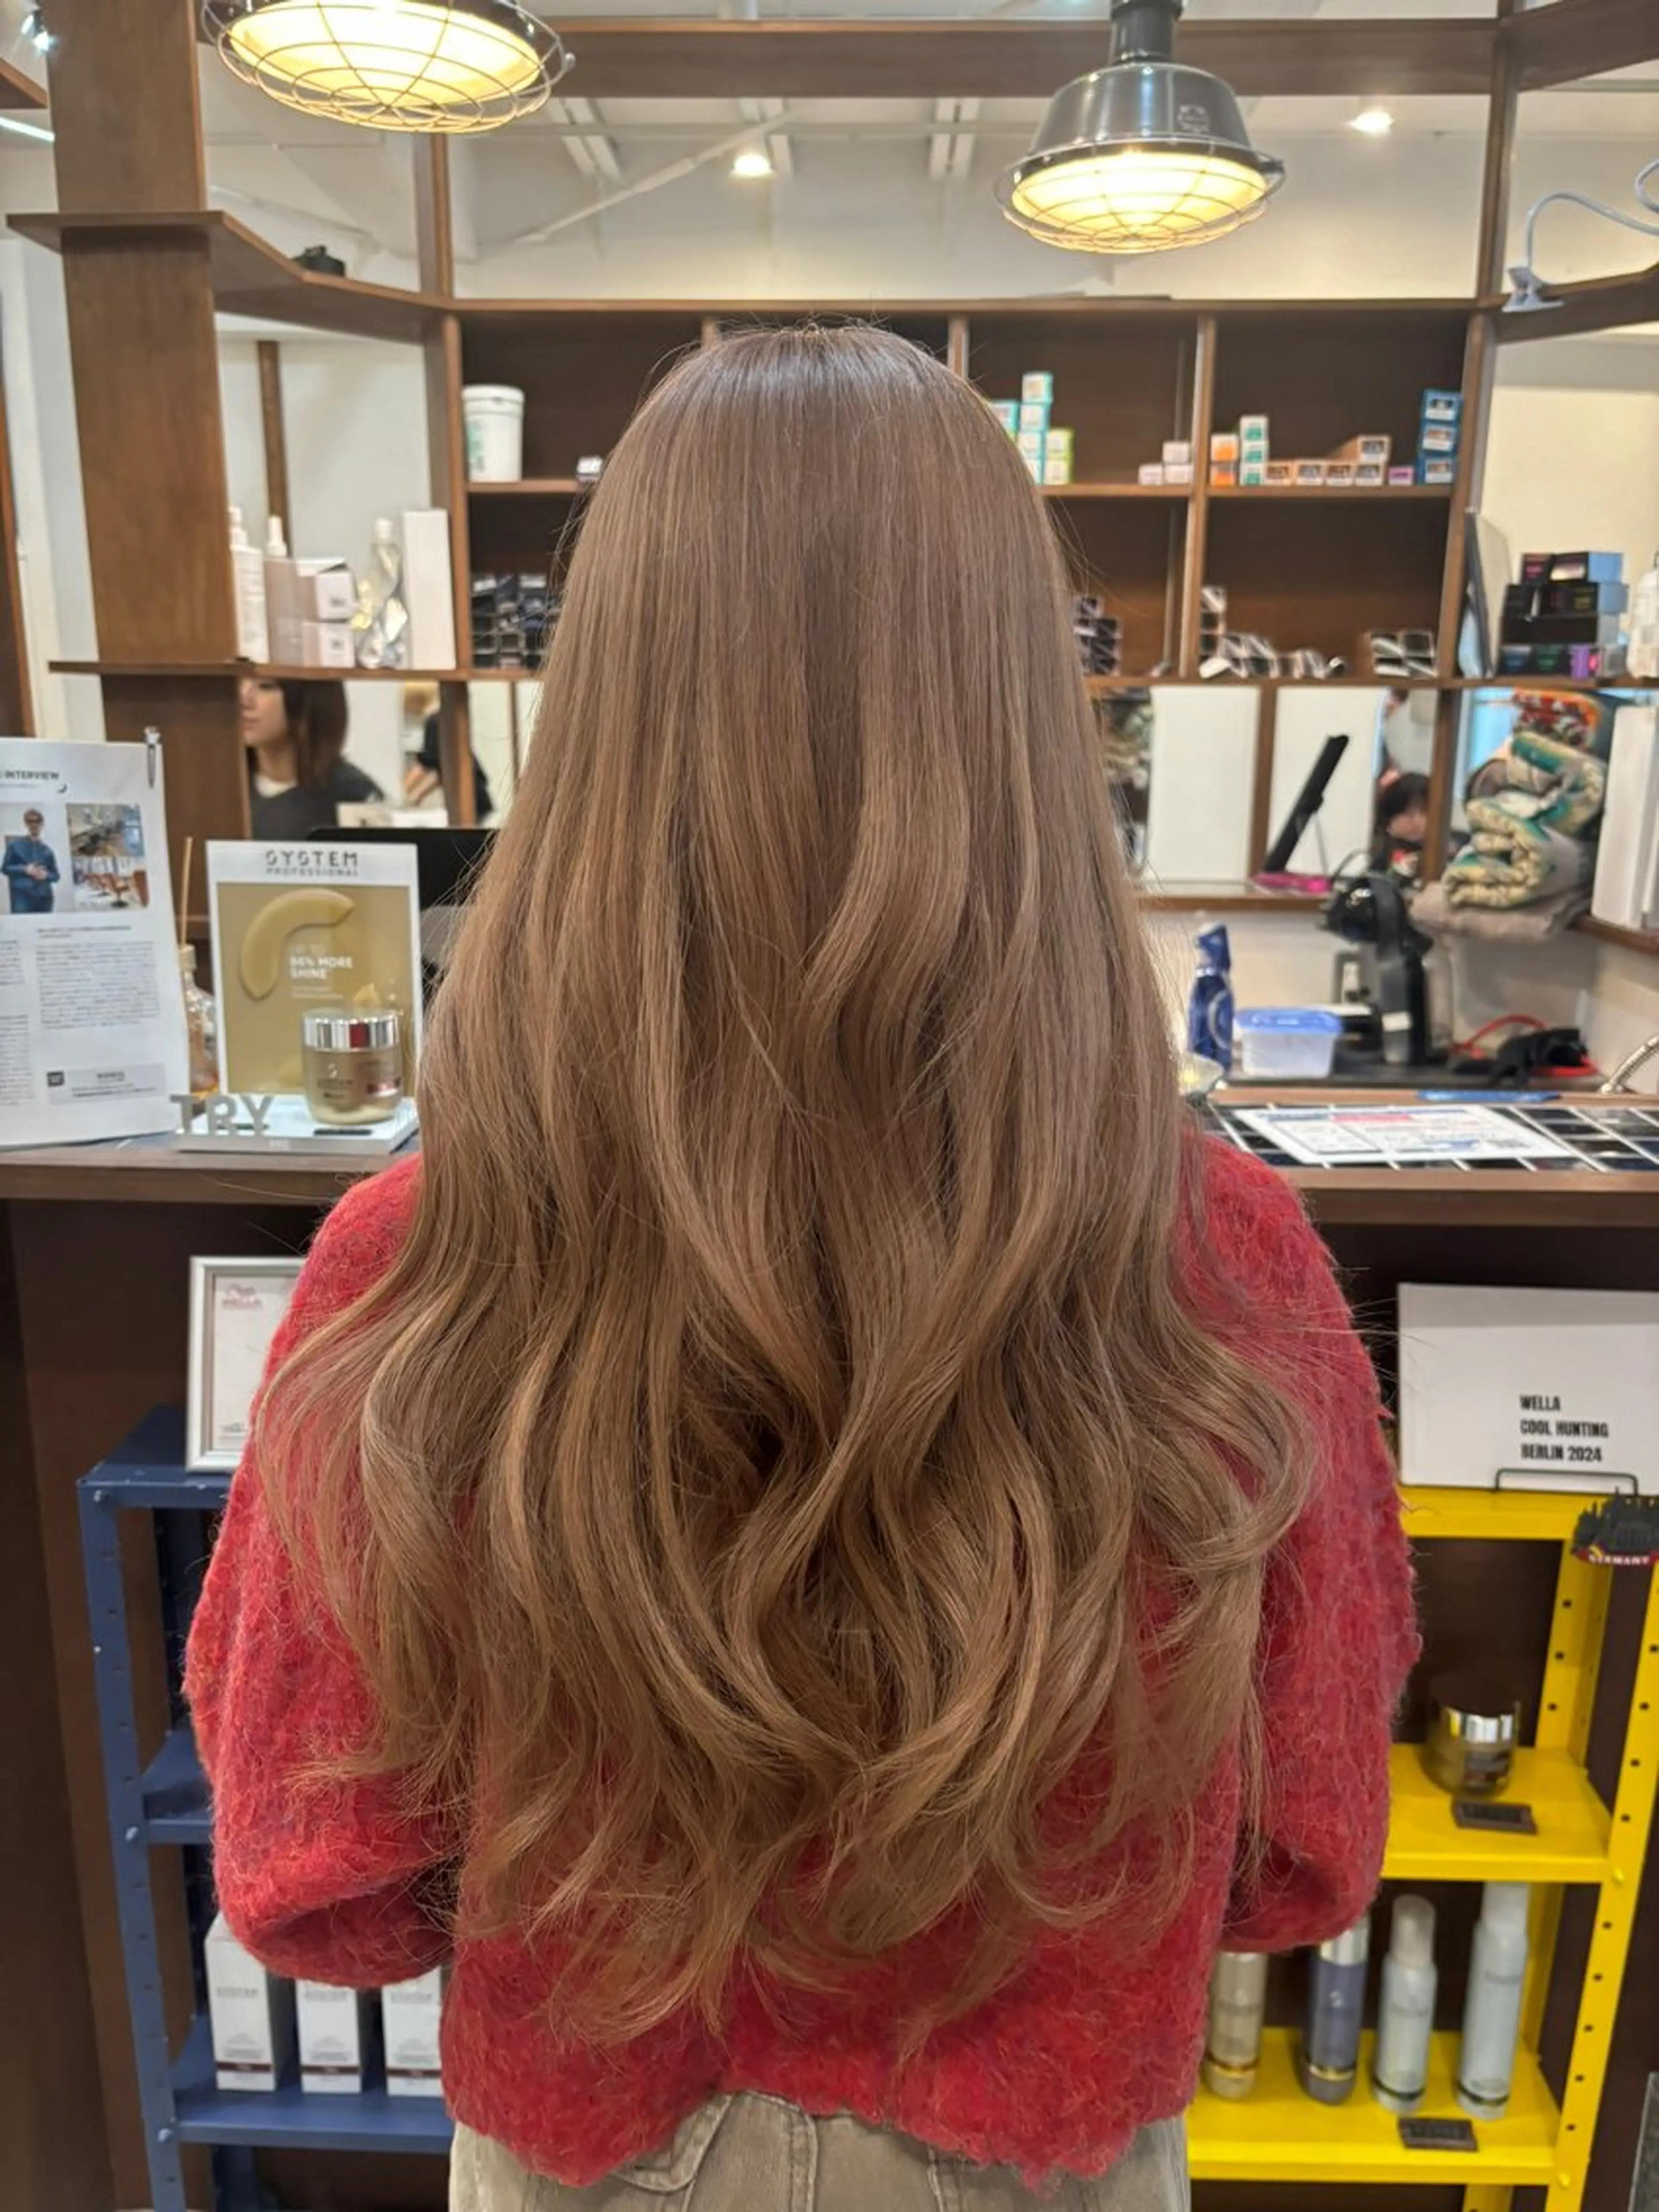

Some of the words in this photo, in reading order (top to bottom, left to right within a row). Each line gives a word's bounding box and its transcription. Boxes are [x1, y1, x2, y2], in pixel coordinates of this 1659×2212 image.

[265, 849, 358, 867] SYSTEM
[1520, 1395, 1561, 1412] WELLA
[1520, 1419, 1552, 1435] COOL
[1555, 1421, 1609, 1438] HUNTING
[1521, 1443, 1564, 1460] BERLIN
[1567, 1445, 1603, 1462] 2024
